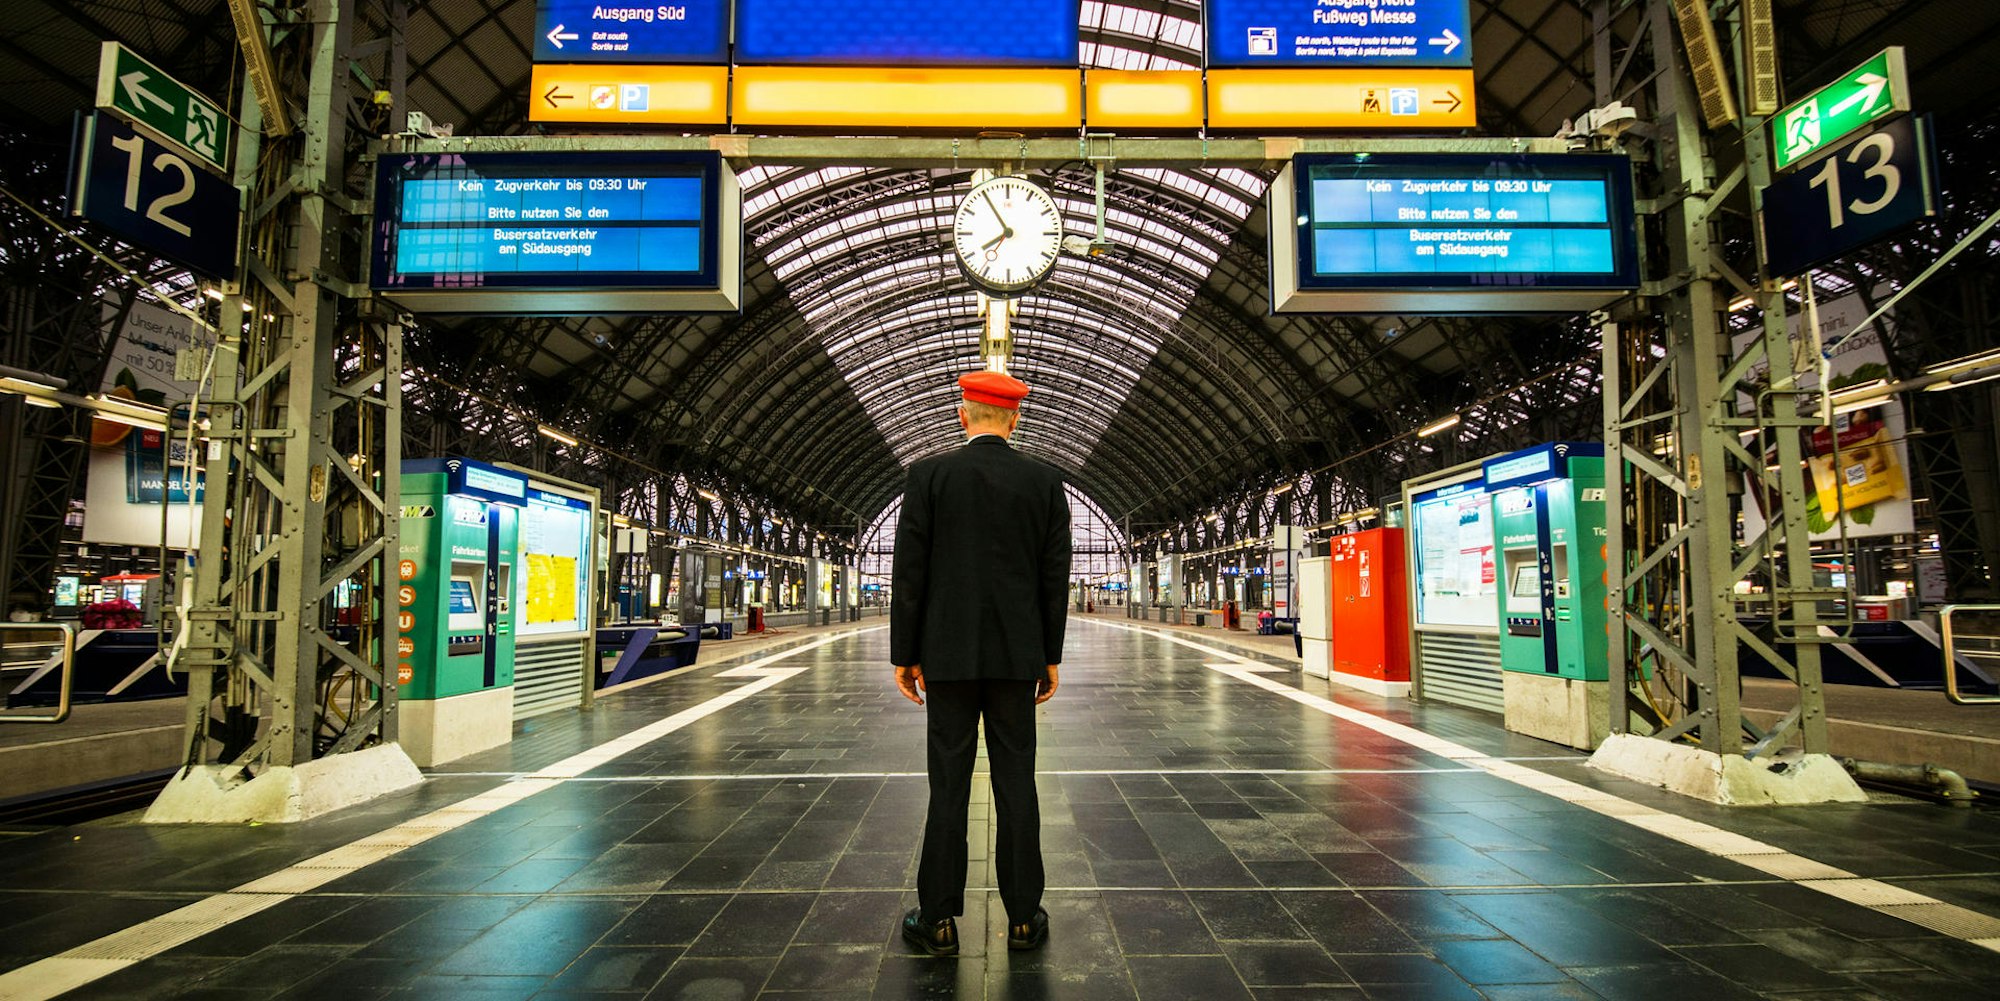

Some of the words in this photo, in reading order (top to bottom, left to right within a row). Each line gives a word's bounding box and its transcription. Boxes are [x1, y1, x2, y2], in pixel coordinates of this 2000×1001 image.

[592, 6, 654, 22] Ausgang
[657, 6, 685, 20] Süd
[1313, 9, 1367, 26] Fußweg
[1370, 9, 1416, 24] Messe
[592, 32, 607, 40] Exit
[607, 32, 628, 40] south
[592, 42, 613, 50] Sortie
[112, 135, 196, 237] 12
[458, 180, 483, 191] Kein
[494, 179, 560, 193] Zugverkehr
[566, 179, 583, 191] bis
[589, 179, 622, 190] 09:30
[627, 179, 647, 191] Uhr
[1366, 180, 1392, 192] Kein
[1402, 180, 1468, 194] Zugverkehr
[1472, 181, 1489, 192] bis
[1494, 181, 1527, 192] 09:30
[1532, 181, 1551, 192] Uhr
[1809, 132, 1901, 230] 13
[488, 207, 516, 218] Bitte
[521, 207, 559, 218] nutzen
[565, 207, 582, 218] Sie
[588, 207, 609, 218] den
[1398, 208, 1426, 219] Bitte
[1431, 208, 1469, 219] nutzen
[1473, 207, 1491, 219] Sie
[1496, 208, 1517, 219] den
[493, 228, 598, 240] Busersatzverkehr
[1409, 229, 1512, 241] Busersatzverkehr
[499, 245, 516, 254] am
[522, 243, 592, 256] Südausgang
[1416, 245, 1434, 255] am
[1439, 243, 1508, 257] Südausgang
[129, 312, 163, 334] Unser
[126, 354, 143, 366] mit
[399, 588, 412, 603] S
